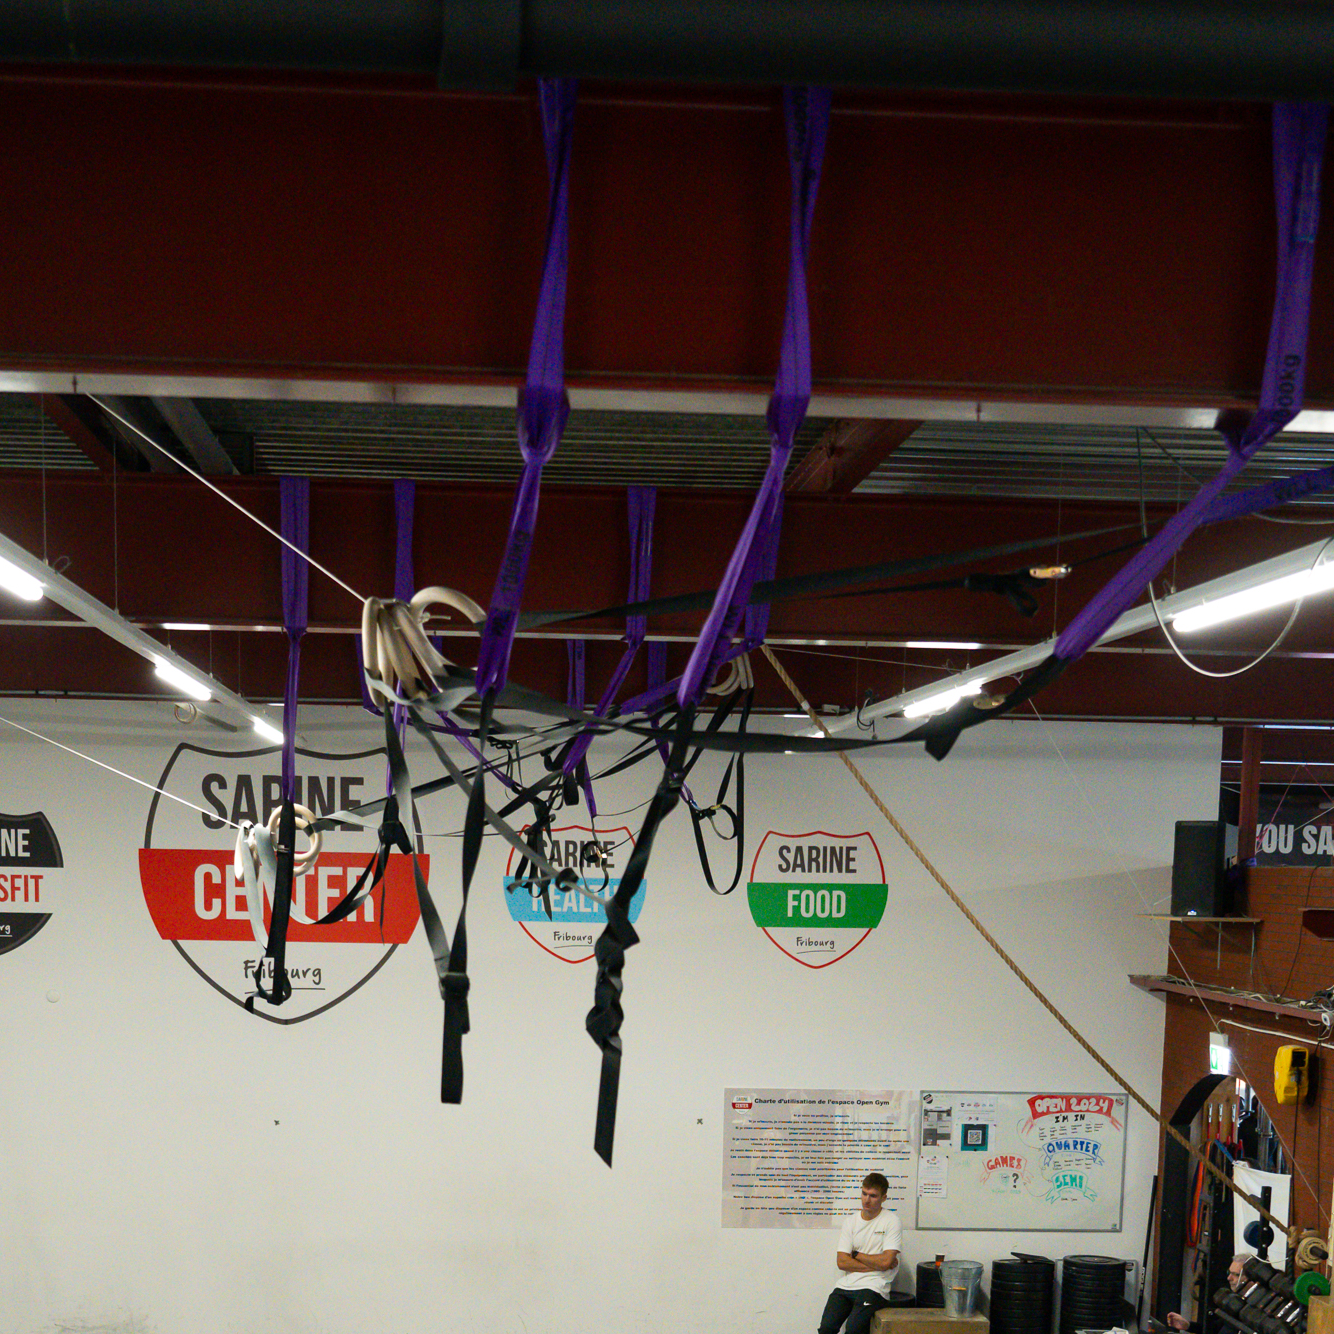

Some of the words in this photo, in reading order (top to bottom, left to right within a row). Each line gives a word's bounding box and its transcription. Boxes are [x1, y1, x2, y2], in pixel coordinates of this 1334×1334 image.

[778, 845, 858, 873] SARINE
[787, 889, 847, 918] FOOD
[553, 931, 593, 945] Fribourg
[796, 936, 835, 949] Fribourg
[243, 959, 322, 985] Friburg
[827, 1099, 855, 1107] l'espace
[1034, 1097, 1066, 1113] OPEN
[1069, 1097, 1108, 1113] 2024
[1054, 1114, 1069, 1123] I'M
[1047, 1139, 1099, 1156] QUARTER
[986, 1155, 1022, 1171] GAMES
[1054, 1174, 1084, 1189] SEMI
